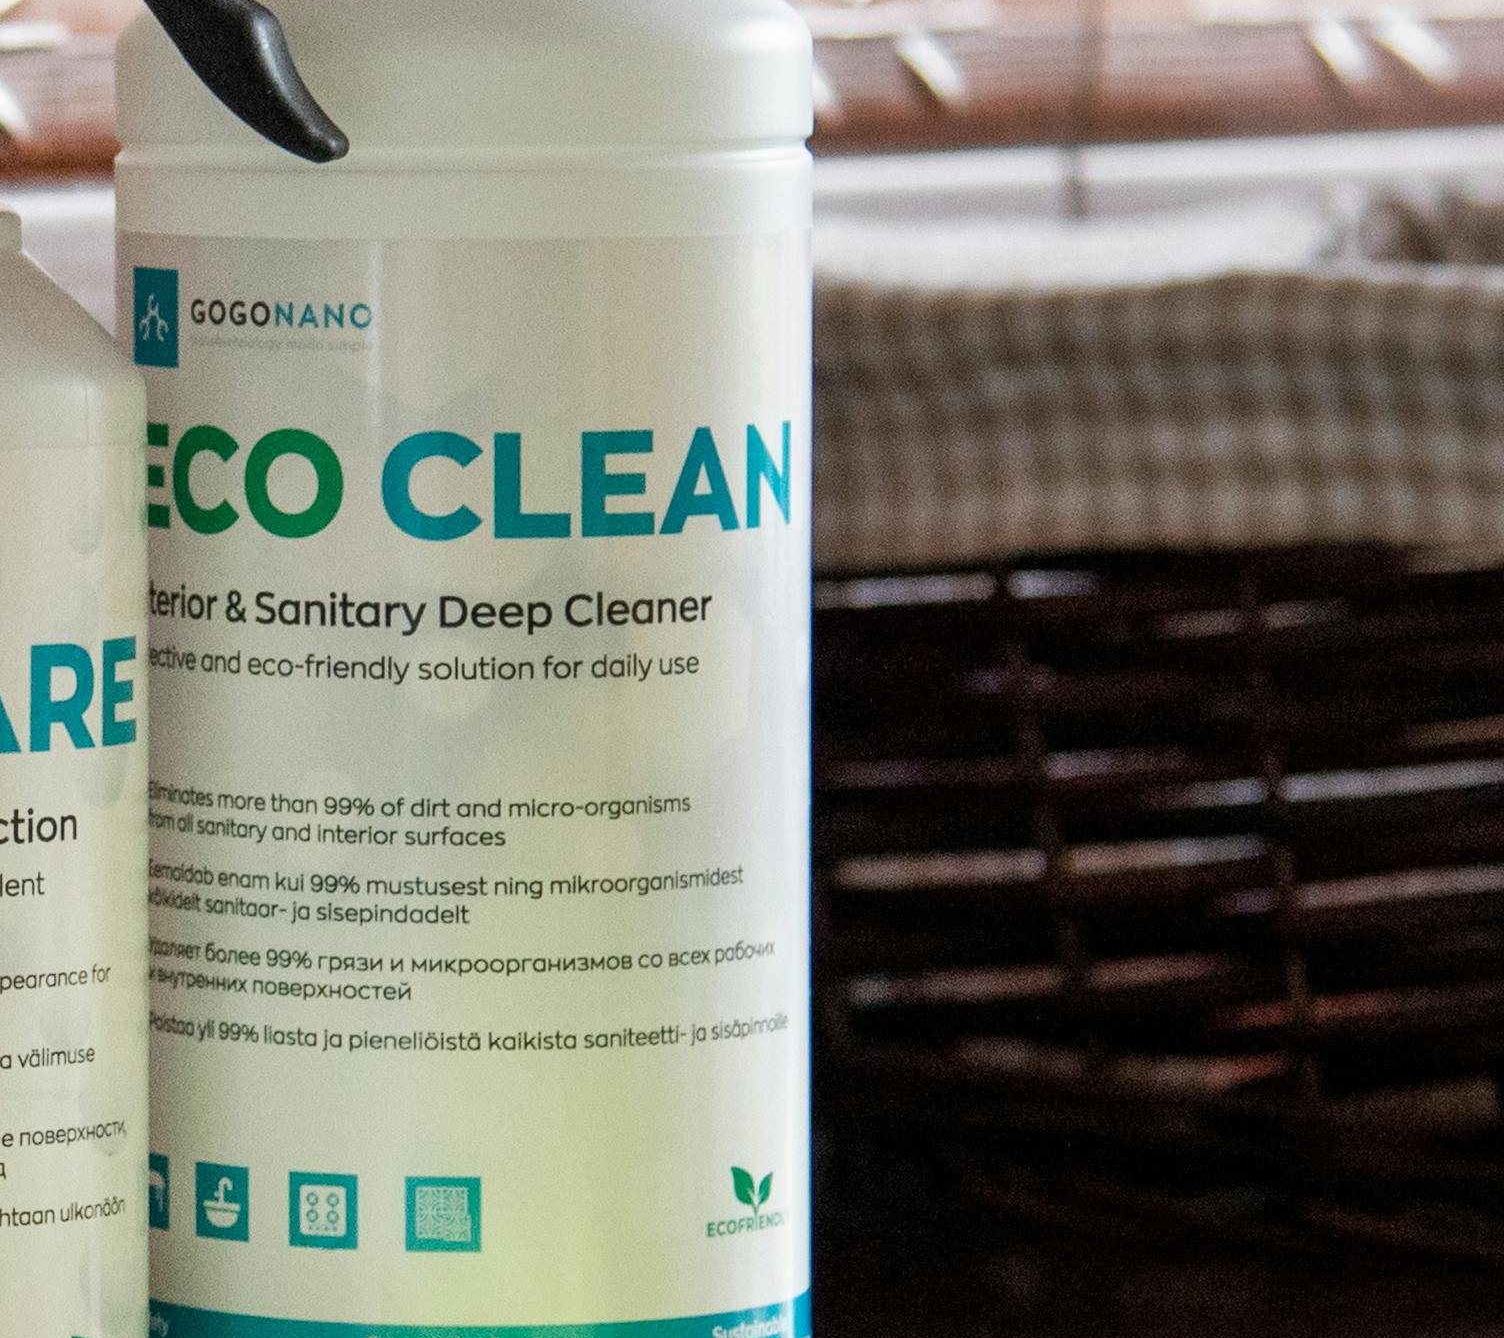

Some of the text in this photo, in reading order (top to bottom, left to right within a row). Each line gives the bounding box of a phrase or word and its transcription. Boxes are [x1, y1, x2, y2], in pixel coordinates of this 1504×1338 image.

[191, 299, 373, 330] GOGONANO
[381, 420, 793, 541] CLEAN
[225, 590, 246, 623] &
[255, 591, 427, 635] Sanitary
[439, 595, 554, 634] Deep
[564, 590, 713, 627] Cleaner
[201, 650, 241, 674] and
[248, 654, 412, 685] eco-friendly
[418, 655, 536, 681] solution
[542, 652, 580, 680] for
[591, 651, 653, 684] daily
[658, 654, 700, 678] use
[218, 793, 266, 811] more
[271, 793, 318, 814] than
[324, 796, 375, 817] 99%
[381, 798, 405, 818] of
[410, 797, 452, 818] dirt
[456, 798, 501, 818] and
[508, 795, 691, 820] micro-organisms
[197, 819, 267, 843] sanitary
[272, 824, 311, 842] and
[317, 824, 399, 846] interior
[404, 827, 507, 847] surfaces
[218, 872, 269, 890] enam
[275, 872, 305, 892] kui
[310, 874, 360, 894] 99%
[366, 875, 489, 896] mustusest
[494, 877, 544, 899] ning
[550, 865, 744, 896] mikroorganismidest
[205, 896, 288, 918] sanitaar-
[292, 901, 311, 924] ja
[316, 904, 470, 925] sisepindadelt
[91, 963, 111, 984] for
[205, 942, 261, 966] более
[266, 948, 313, 970] 99%
[318, 955, 383, 974] грязи
[389, 958, 404, 973] и
[411, 955, 633, 977] микроорганизмов
[638, 953, 663, 969] со
[668, 949, 711, 968] всех
[252, 979, 413, 1001] поверхностей
[218, 1021, 260, 1044] 99%
[264, 1025, 318, 1047] liasta
[322, 1028, 342, 1052] ja
[348, 1030, 482, 1052] pieneliöistä
[488, 1027, 578, 1051] kaikista
[583, 1023, 688, 1049] saniteetti-
[690, 1023, 707, 1046] ja
[17, 1047, 96, 1069] välimuse
